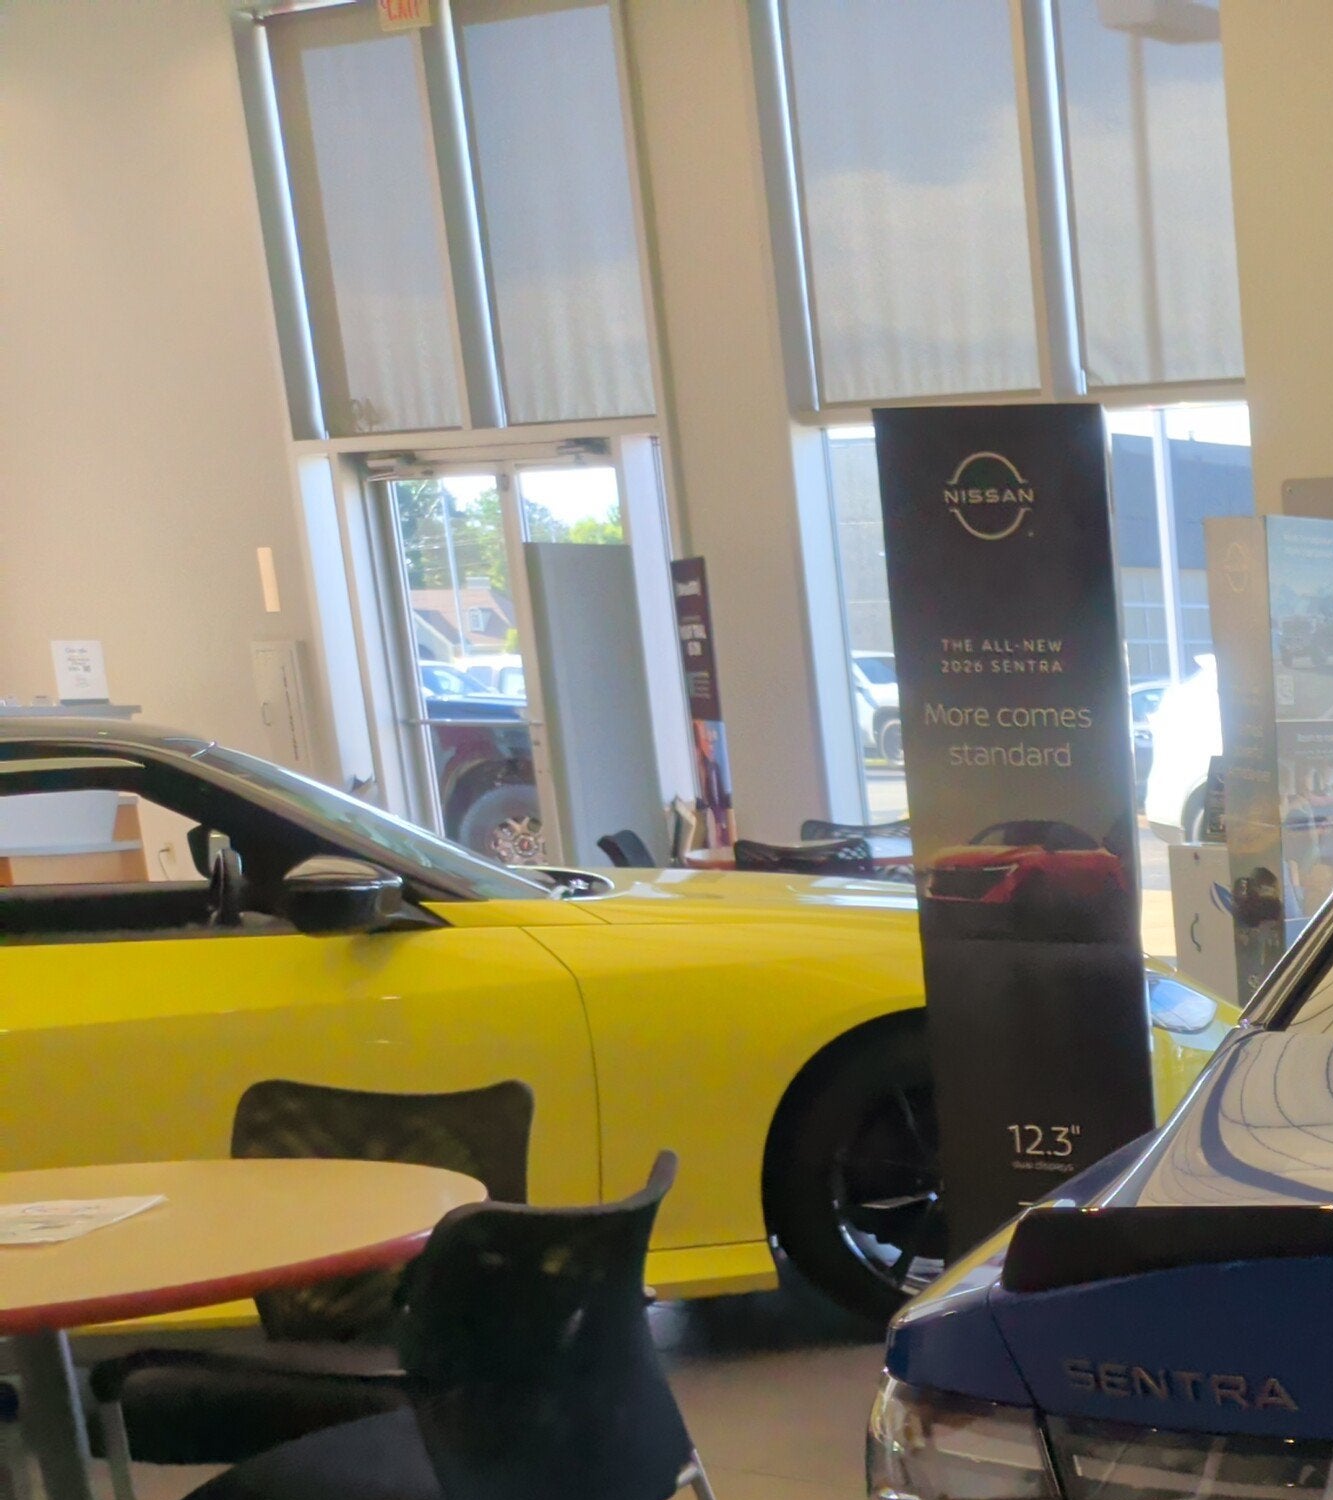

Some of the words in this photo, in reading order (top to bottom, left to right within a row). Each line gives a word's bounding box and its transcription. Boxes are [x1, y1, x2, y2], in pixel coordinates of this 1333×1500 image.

[945, 488, 1035, 504] NISSAN
[941, 638, 972, 652] THE
[982, 638, 1063, 653] ALL-NEW
[941, 661, 983, 673] 2026
[992, 660, 1063, 674] SENTRA
[924, 704, 990, 727] More
[997, 707, 1092, 729] comes
[950, 742, 1071, 767] standard
[1007, 1124, 1081, 1157] 12.3"
[1064, 1357, 1299, 1412] SENTRA
